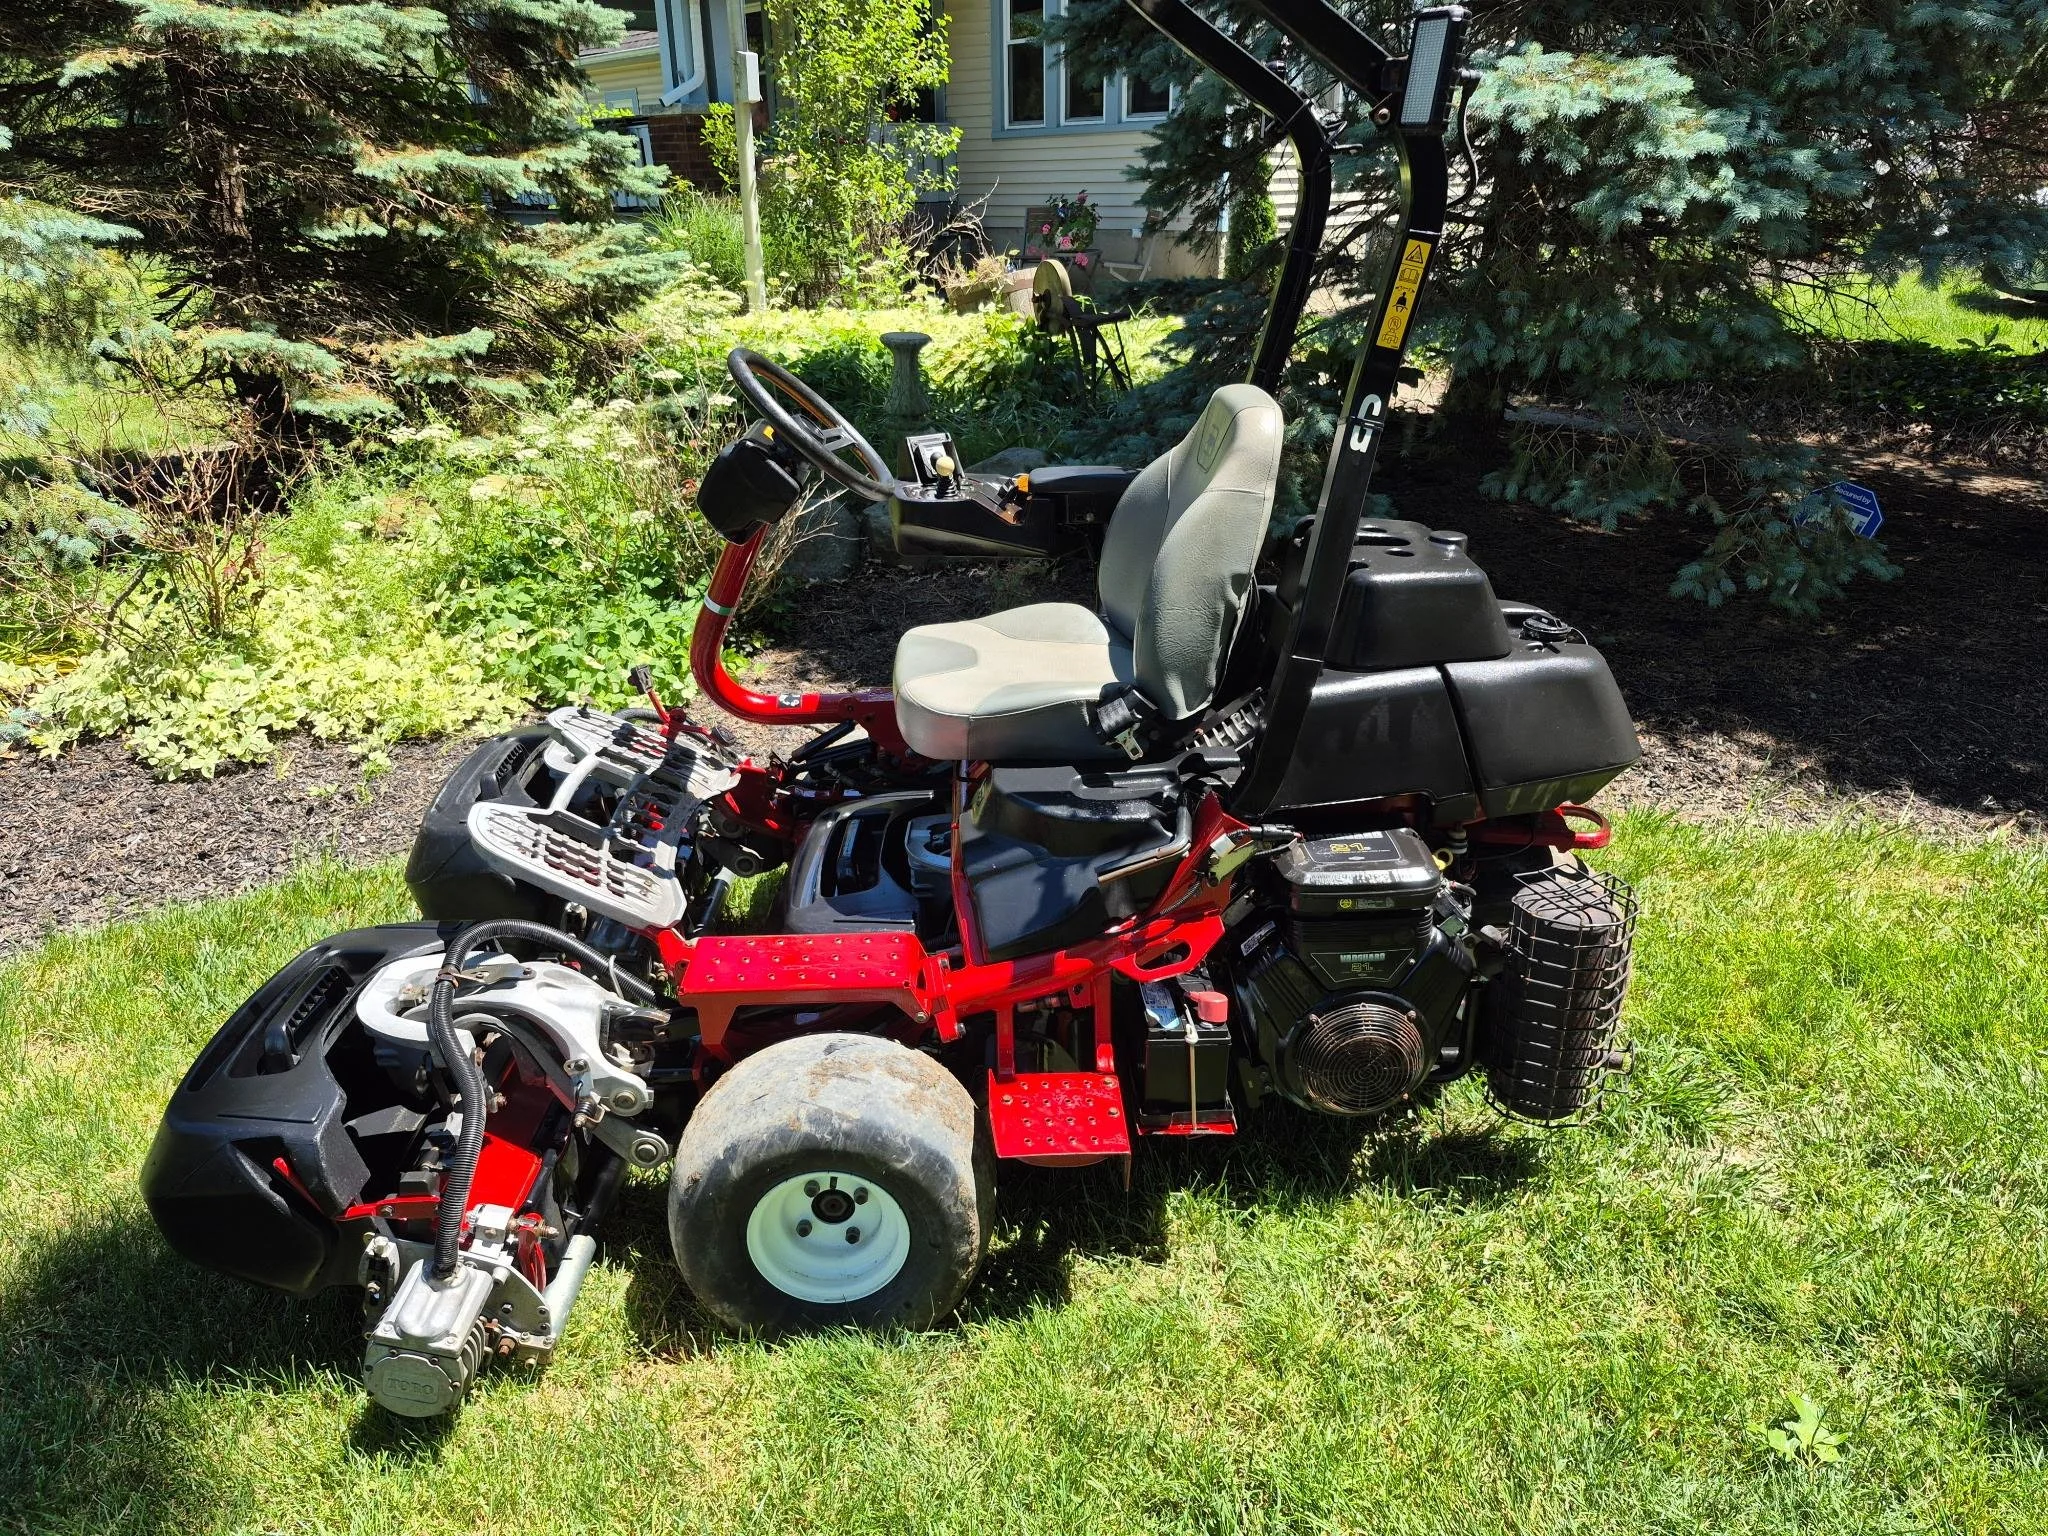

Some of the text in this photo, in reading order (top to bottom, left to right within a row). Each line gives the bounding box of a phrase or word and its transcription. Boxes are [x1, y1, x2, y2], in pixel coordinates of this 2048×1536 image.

[1834, 485, 1872, 505] Secured by
[1340, 952, 1385, 963] VANGUARD
[387, 1378, 434, 1395] TORO
